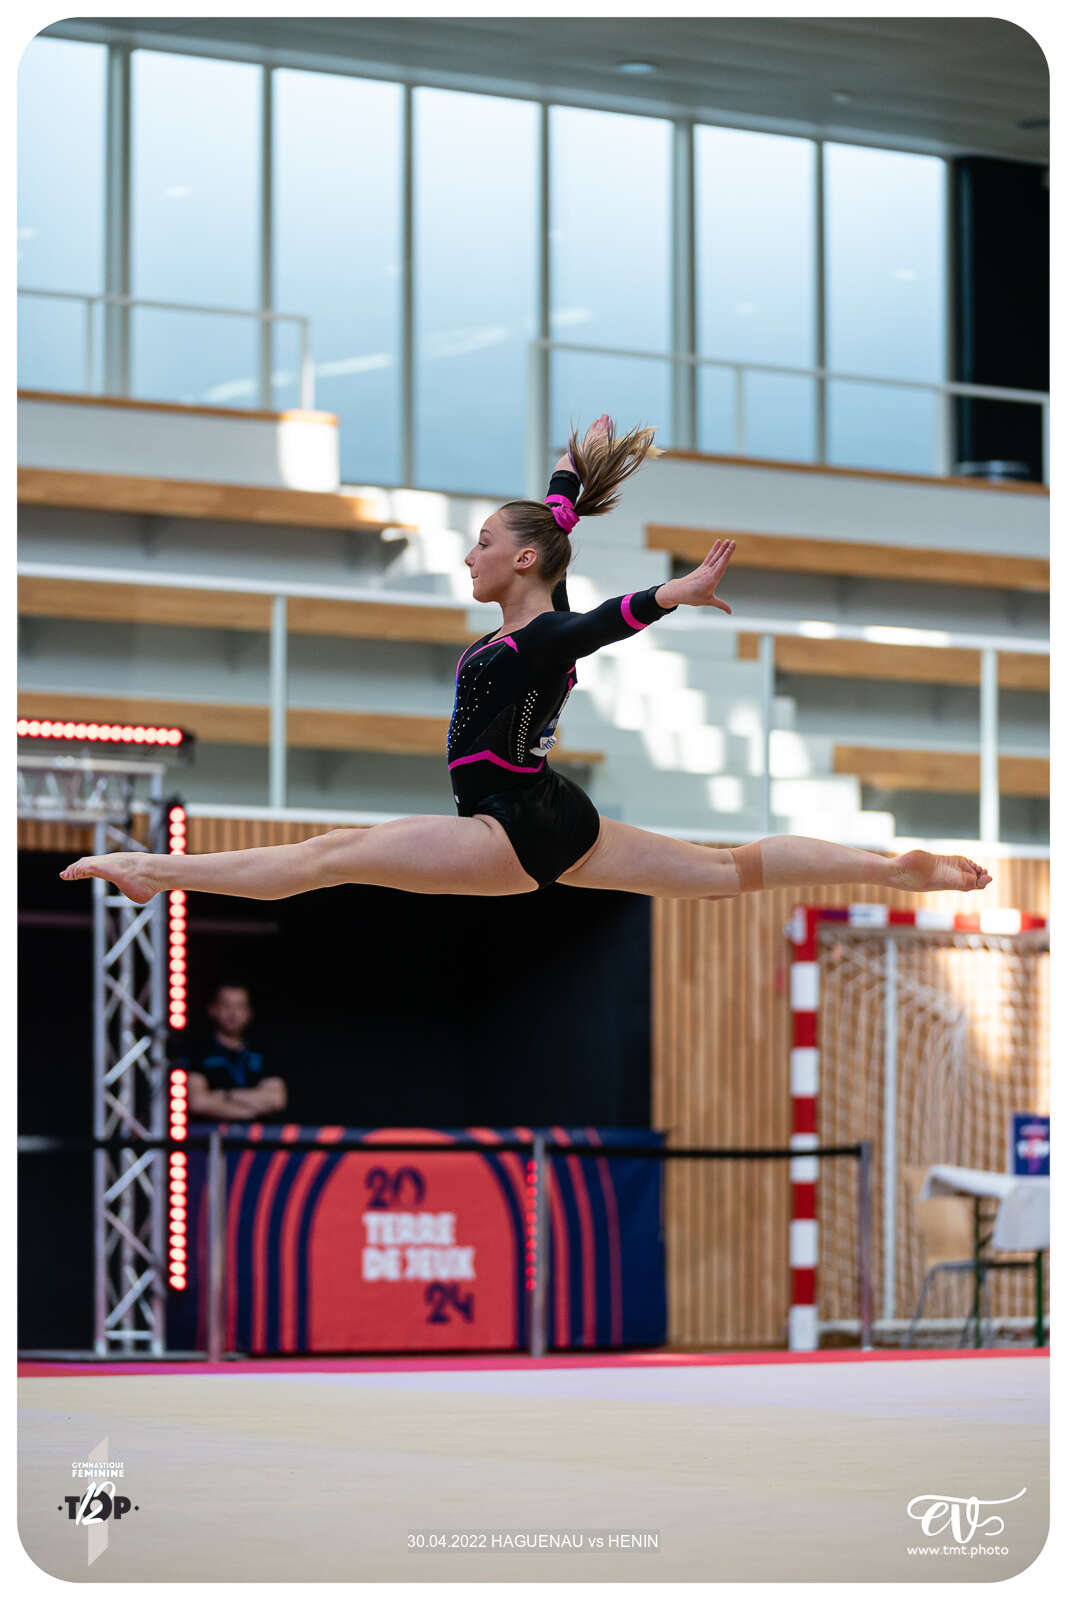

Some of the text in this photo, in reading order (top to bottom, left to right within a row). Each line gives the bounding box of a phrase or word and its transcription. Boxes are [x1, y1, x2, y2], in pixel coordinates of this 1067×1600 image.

[365, 1167, 426, 1209] 20
[362, 1212, 455, 1245] TERRE
[362, 1247, 475, 1281] DE JEUX
[425, 1282, 475, 1324] 24
